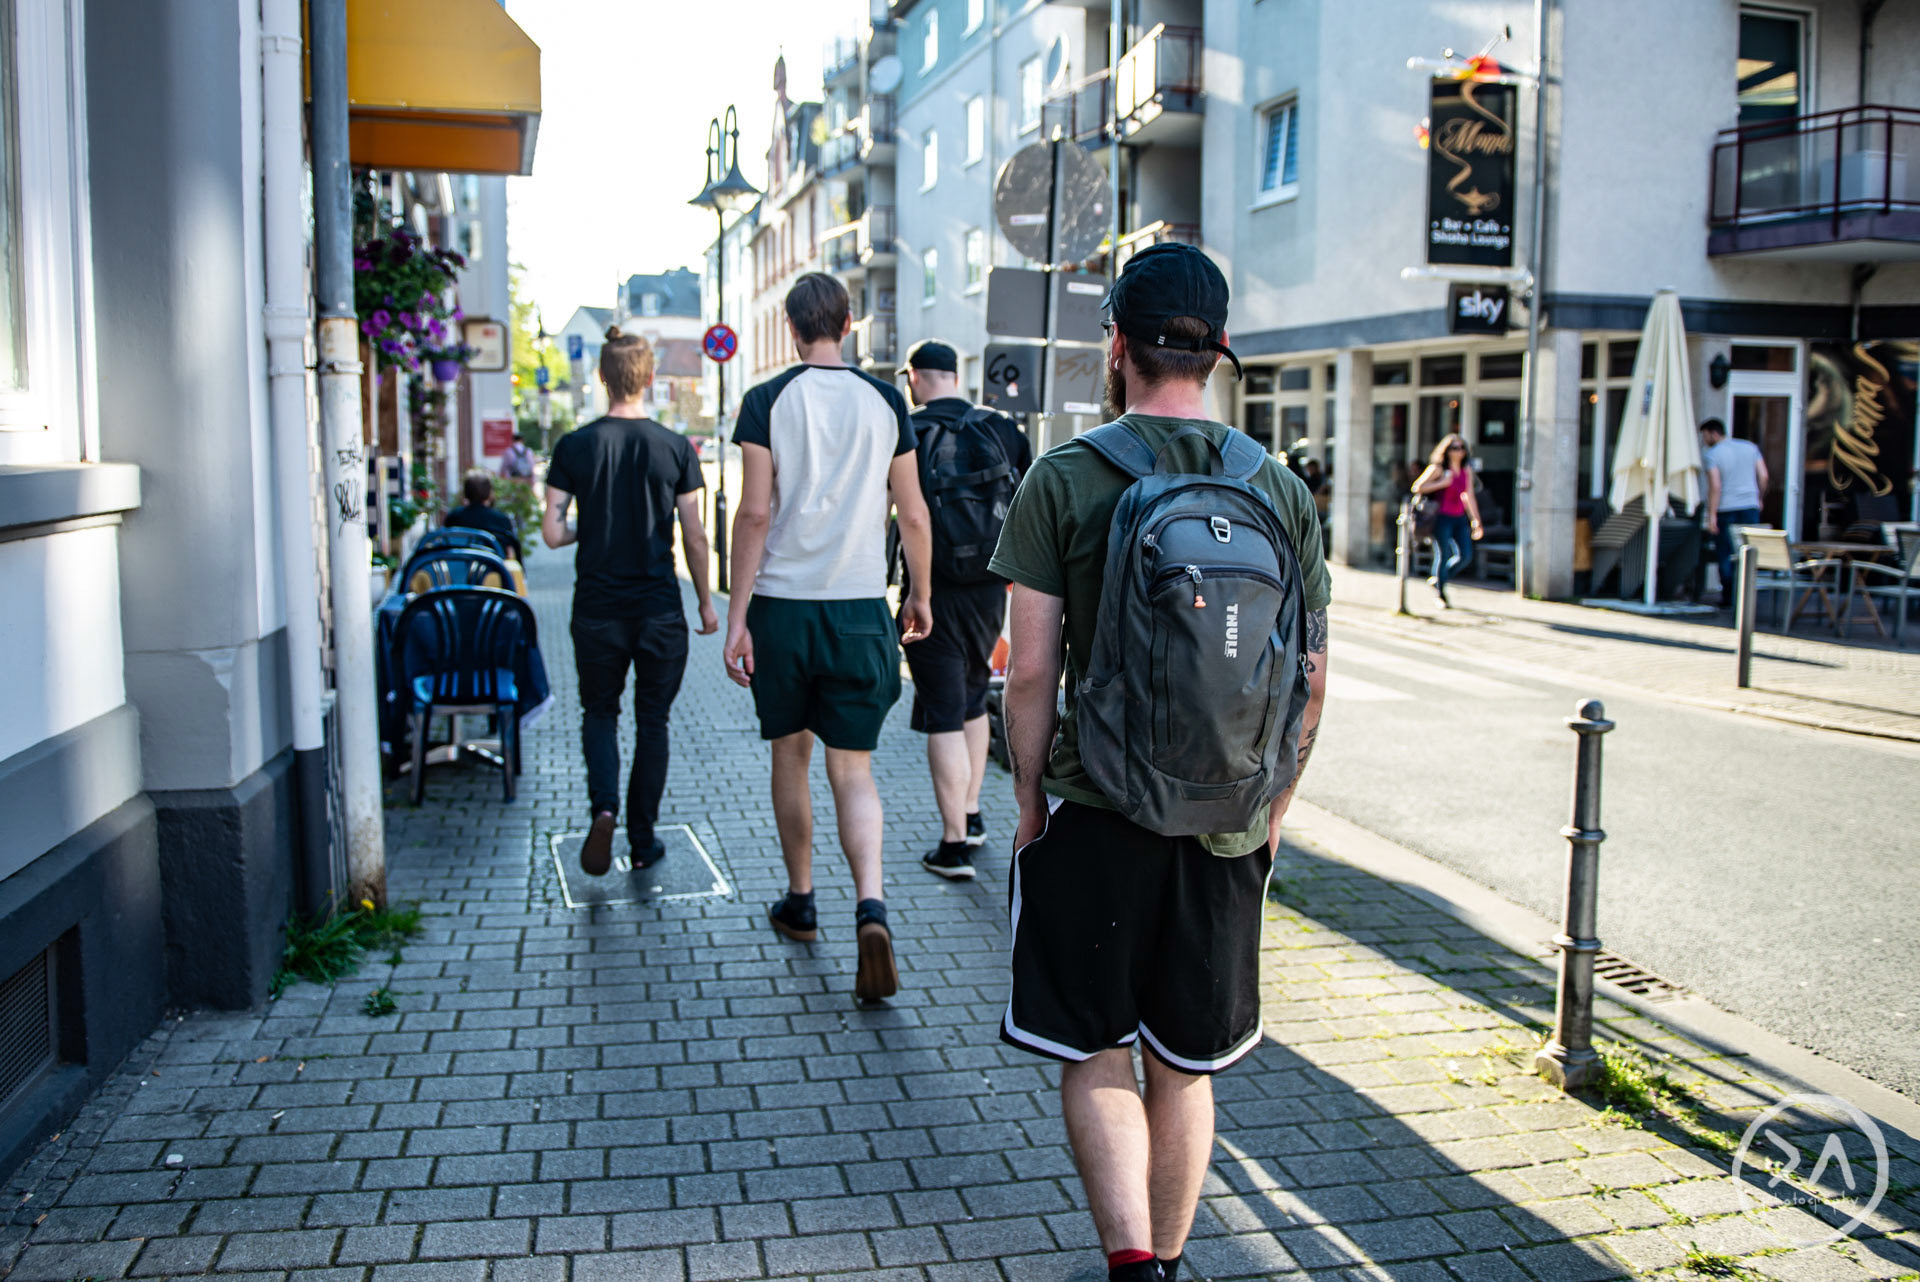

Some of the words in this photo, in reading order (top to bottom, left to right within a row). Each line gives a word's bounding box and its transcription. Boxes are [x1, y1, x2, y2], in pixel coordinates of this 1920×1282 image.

[1442, 217, 1463, 232] Bar
[1431, 229, 1468, 245] Shisha
[1470, 231, 1510, 250] Lounge
[1459, 291, 1504, 325] sky
[1226, 603, 1239, 659] THULE
